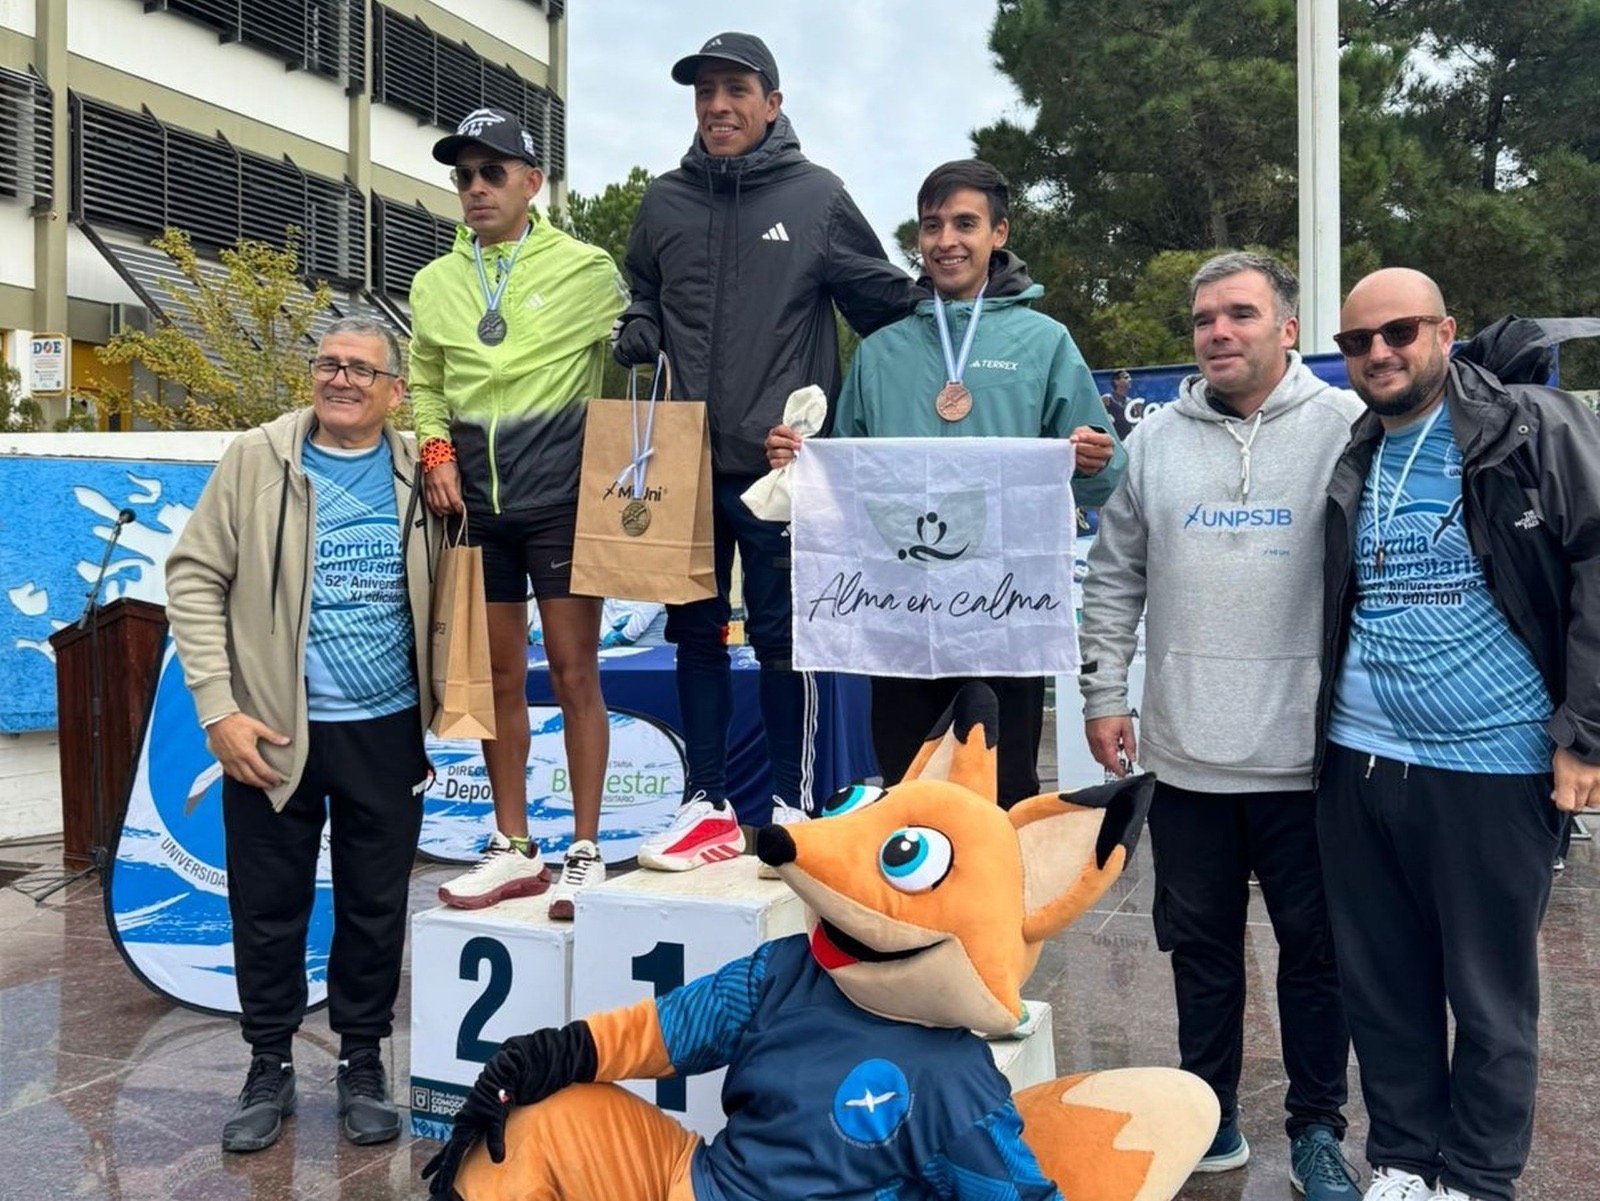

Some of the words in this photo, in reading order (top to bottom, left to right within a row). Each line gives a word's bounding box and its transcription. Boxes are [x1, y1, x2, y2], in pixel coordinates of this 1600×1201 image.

[982, 360, 1019, 370] TERREX
[1202, 509, 1292, 527] UNPSJB
[320, 539, 394, 558] Corrida
[808, 571, 900, 622] Alma
[907, 595, 942, 614] en
[949, 572, 1060, 620] calma
[456, 936, 513, 1064] 2
